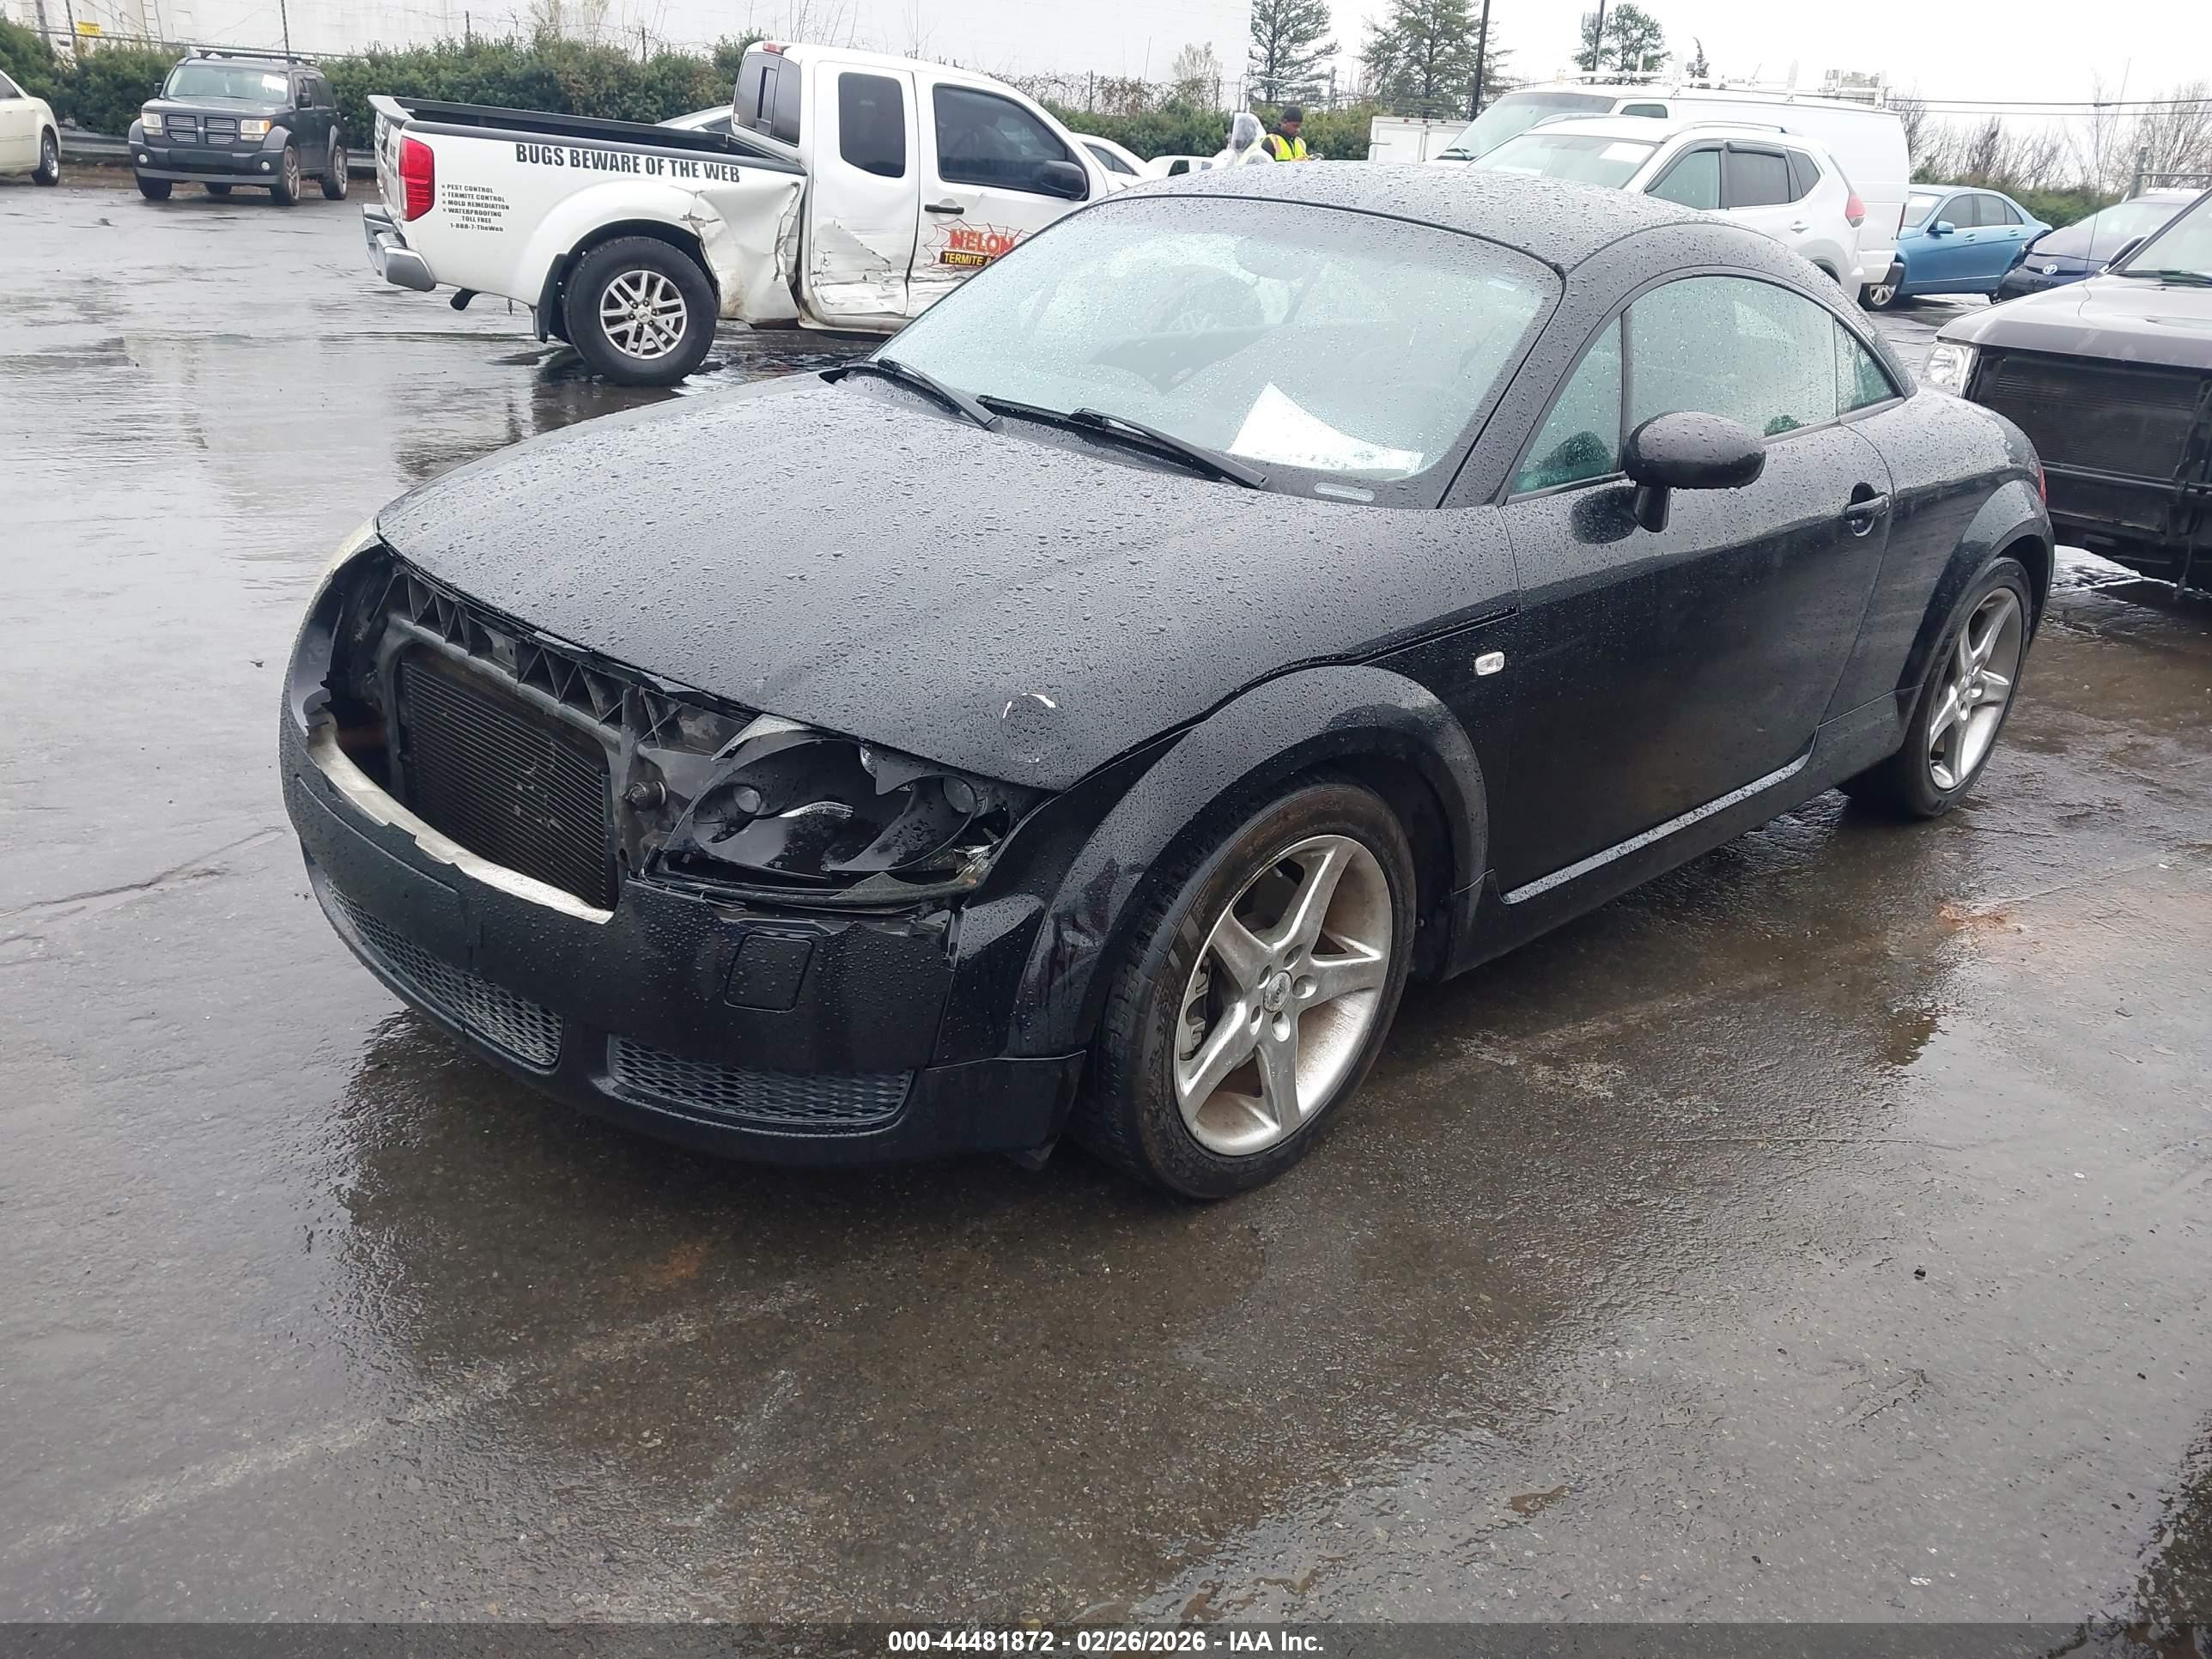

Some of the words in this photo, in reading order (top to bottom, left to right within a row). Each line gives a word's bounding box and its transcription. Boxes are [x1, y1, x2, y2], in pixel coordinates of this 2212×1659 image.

[516, 143, 564, 166] BUGS
[569, 149, 641, 173] BEWARE
[646, 156, 665, 175] OF
[669, 159, 700, 178] THE
[704, 163, 740, 182] WEB
[476, 194, 505, 203] CONTROL
[467, 201, 510, 210] REMEDIATION
[447, 207, 502, 217] WATERPROOFING
[944, 252, 984, 266] TERMITE
